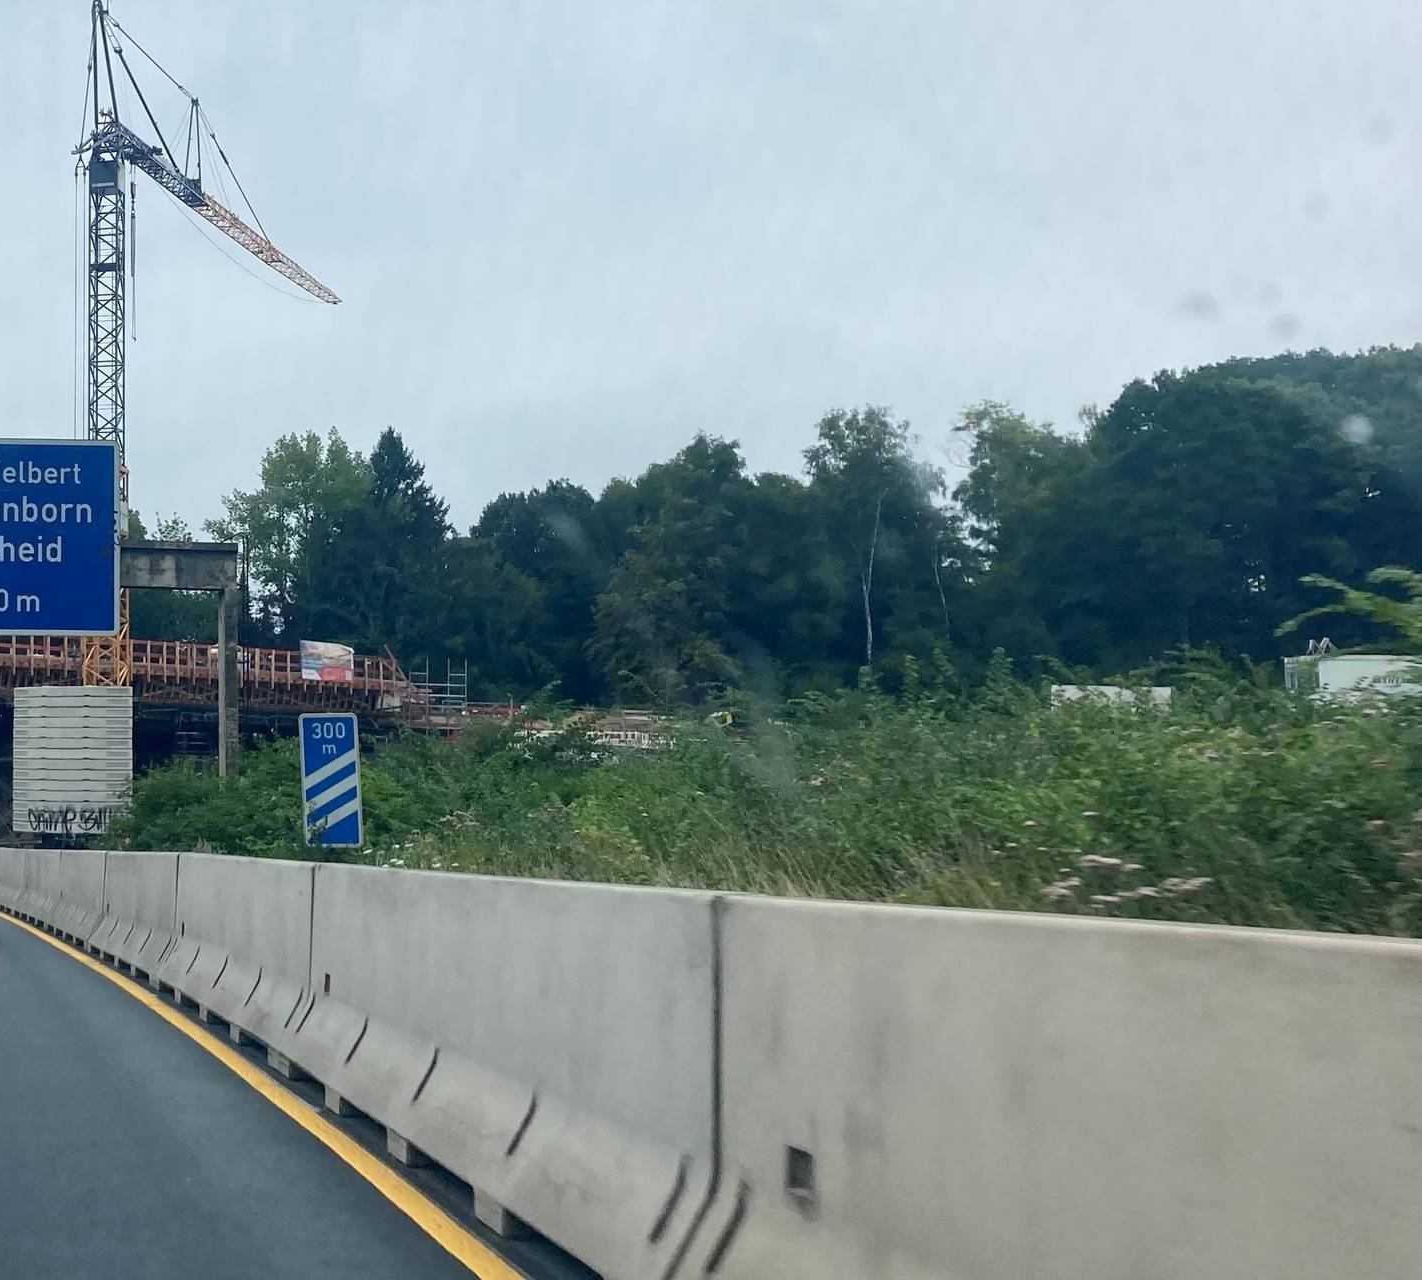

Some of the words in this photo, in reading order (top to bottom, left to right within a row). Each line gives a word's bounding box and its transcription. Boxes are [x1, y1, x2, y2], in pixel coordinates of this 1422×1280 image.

[16, 593, 41, 613] m
[311, 721, 346, 739] 300
[321, 743, 337, 755] m
